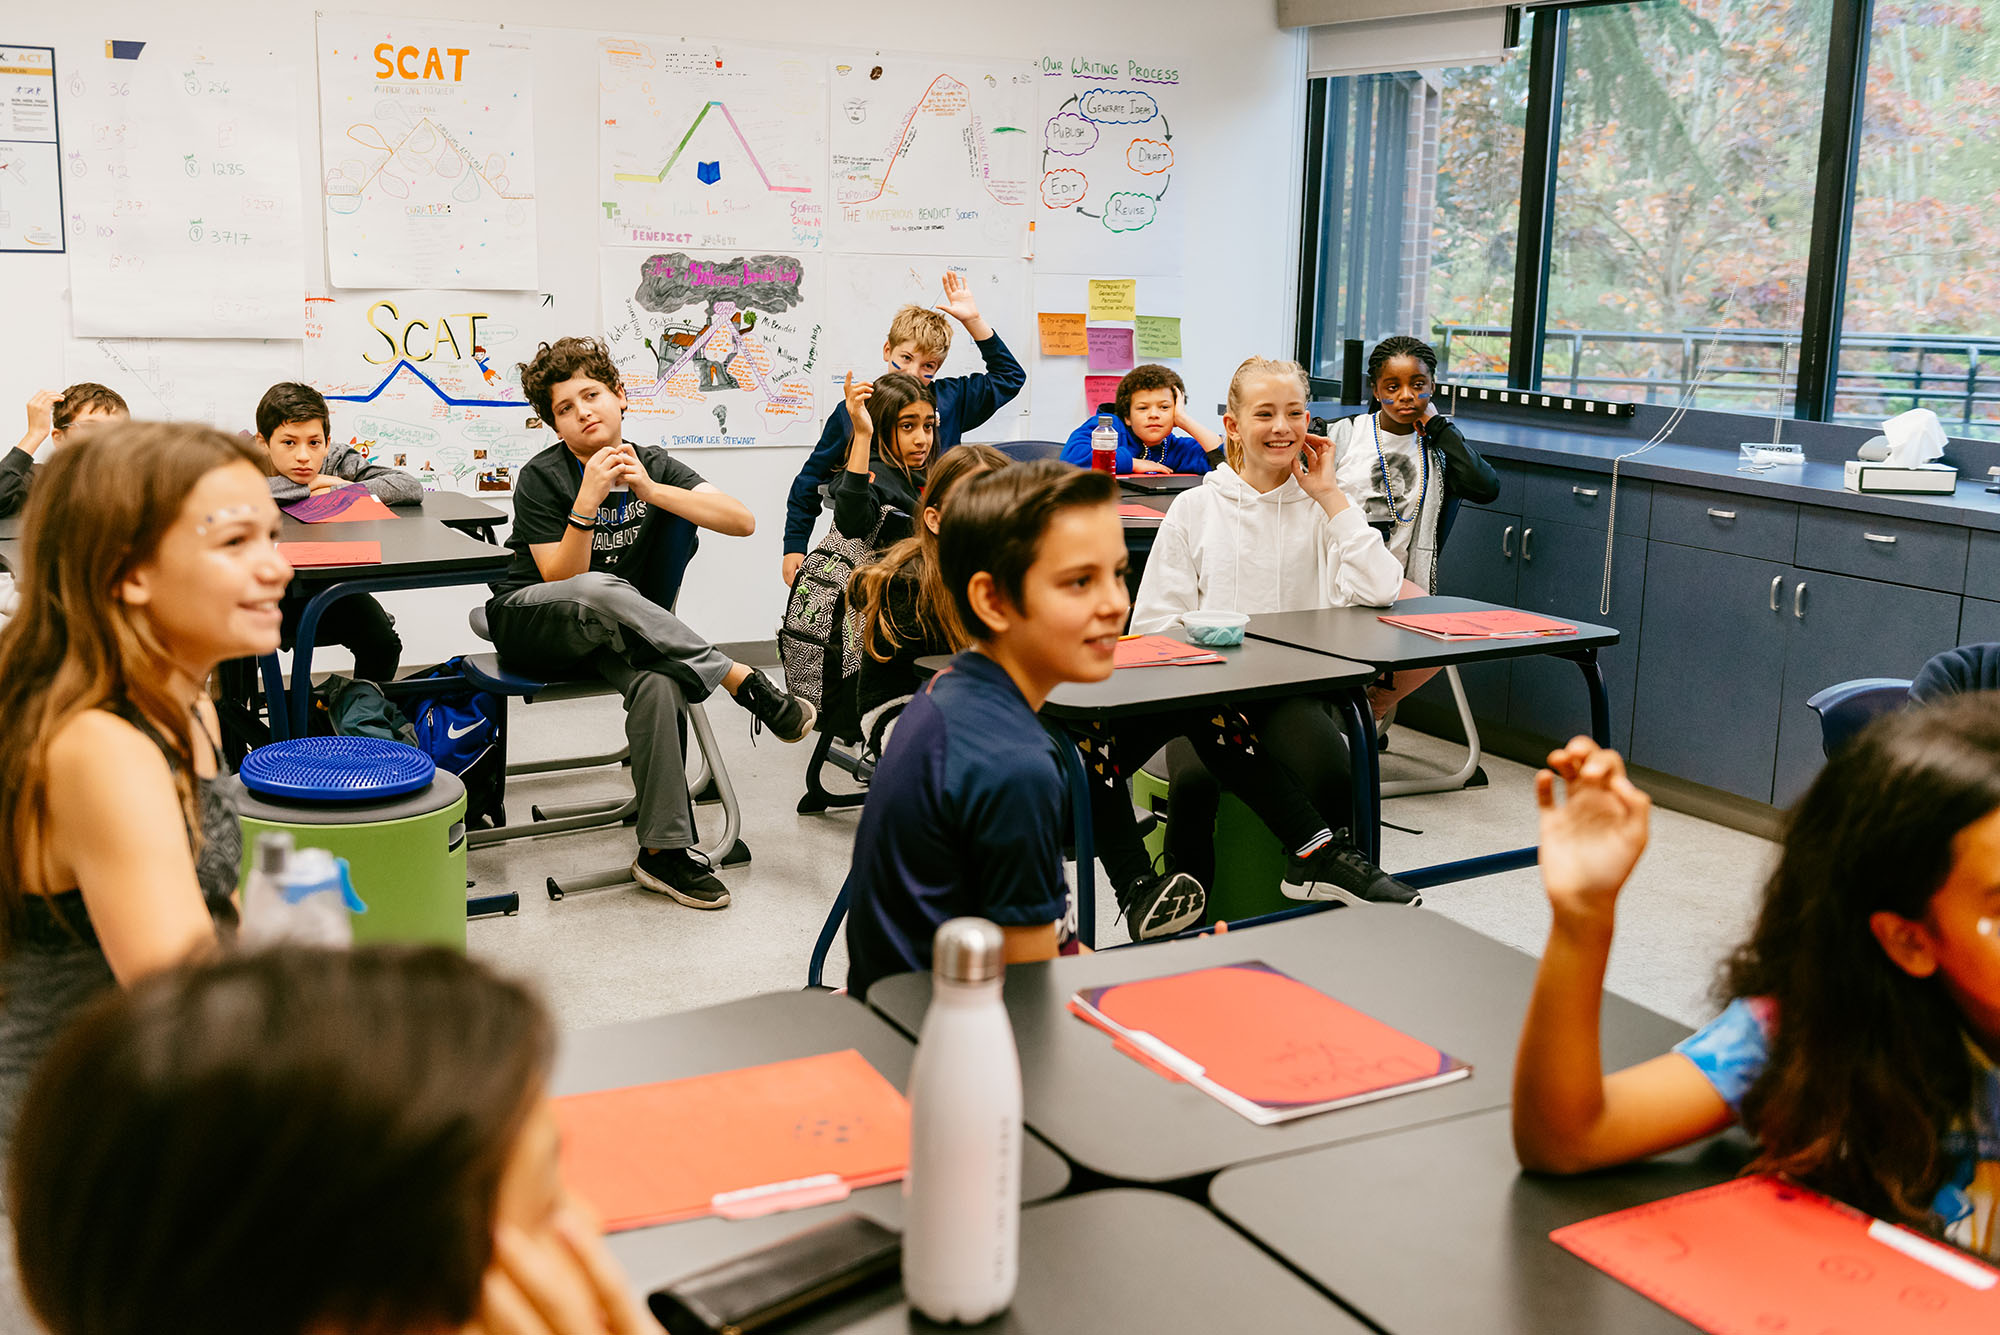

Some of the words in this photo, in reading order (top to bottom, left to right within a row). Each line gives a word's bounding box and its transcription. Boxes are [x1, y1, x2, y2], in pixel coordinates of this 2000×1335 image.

[374, 43, 470, 81] SCAT
[212, 162, 246, 176] 1285
[1052, 177, 1077, 195] EDIT
[210, 230, 253, 246] 3717
[632, 230, 693, 243] BENEDICT
[362, 300, 489, 365] SCAT
[672, 435, 704, 445] TRENTON
[706, 436, 720, 444] LEE
